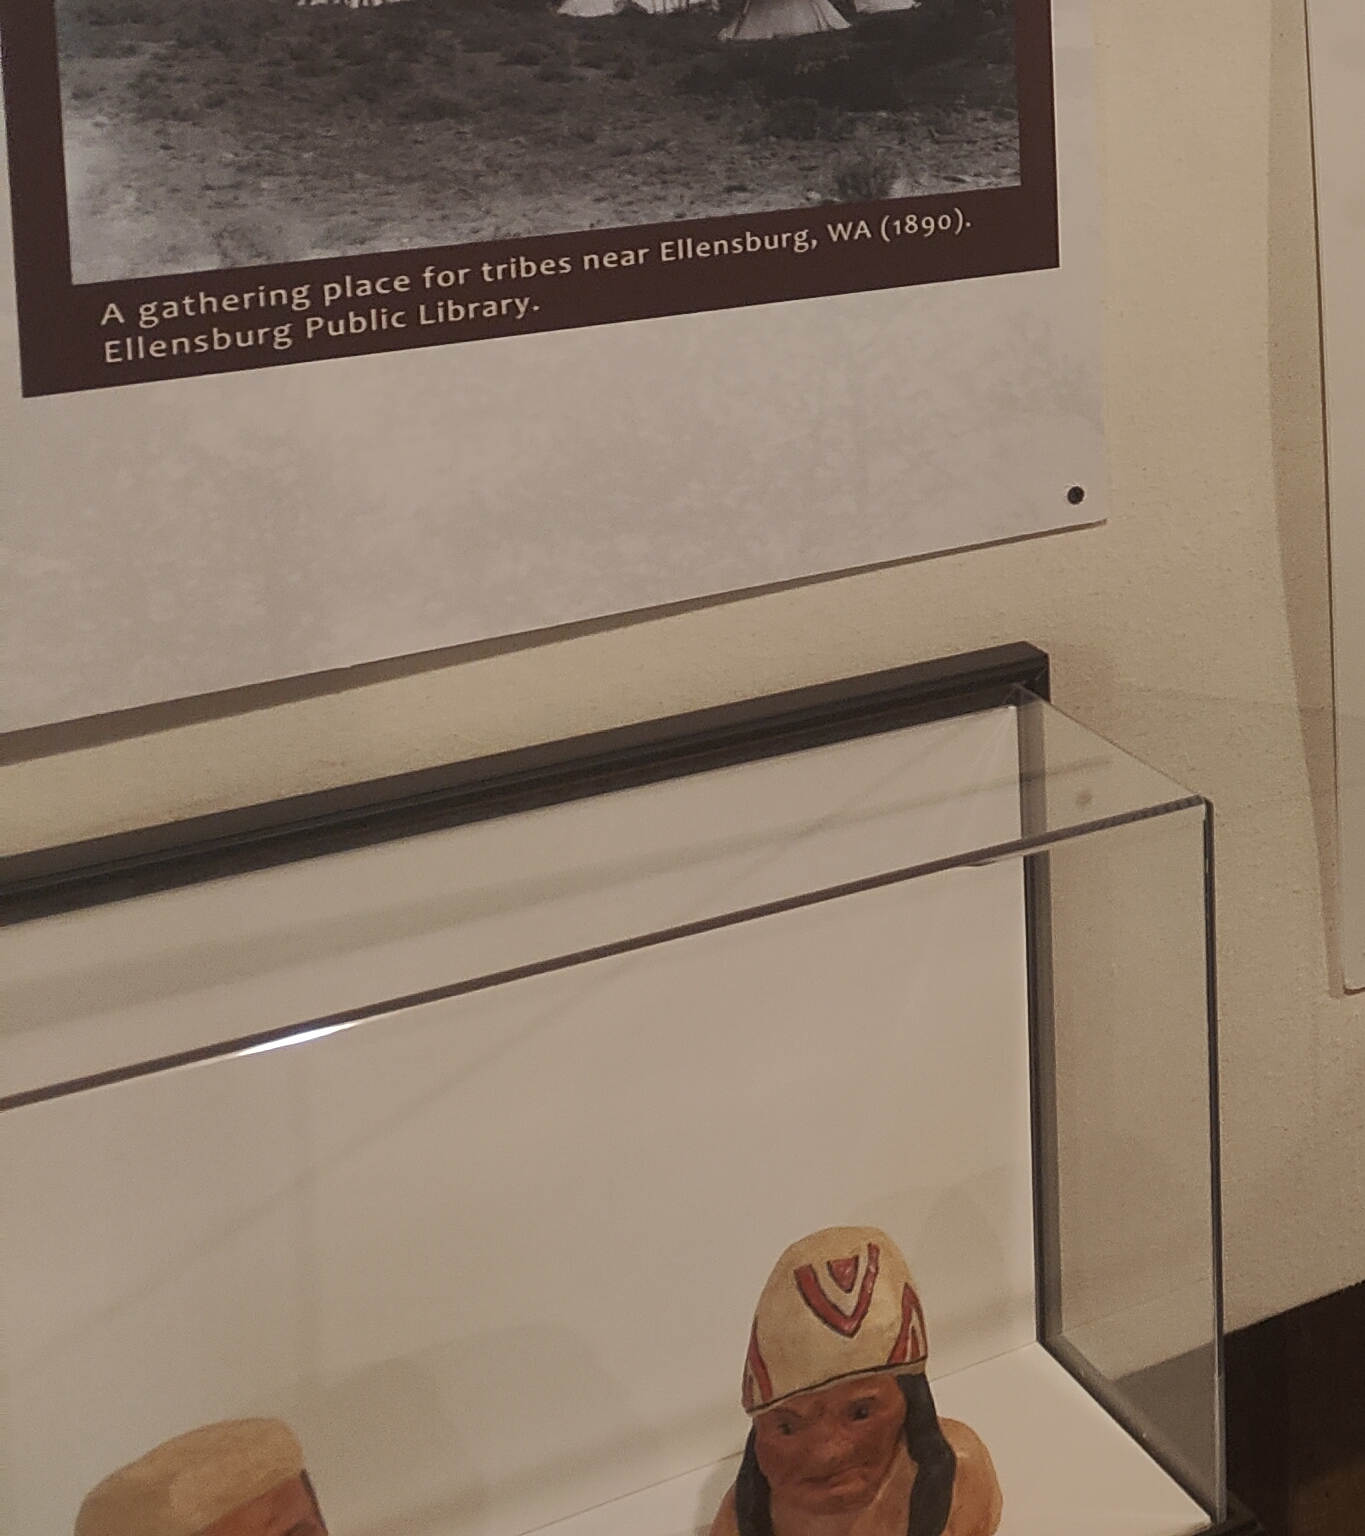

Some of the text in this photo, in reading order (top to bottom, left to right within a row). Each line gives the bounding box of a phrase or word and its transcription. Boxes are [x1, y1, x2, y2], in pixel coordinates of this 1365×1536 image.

[99, 206, 971, 329] A gathering place for tribes near Ellensburg, WA (1890).
[103, 295, 540, 363] Ellensburg Public Library.
